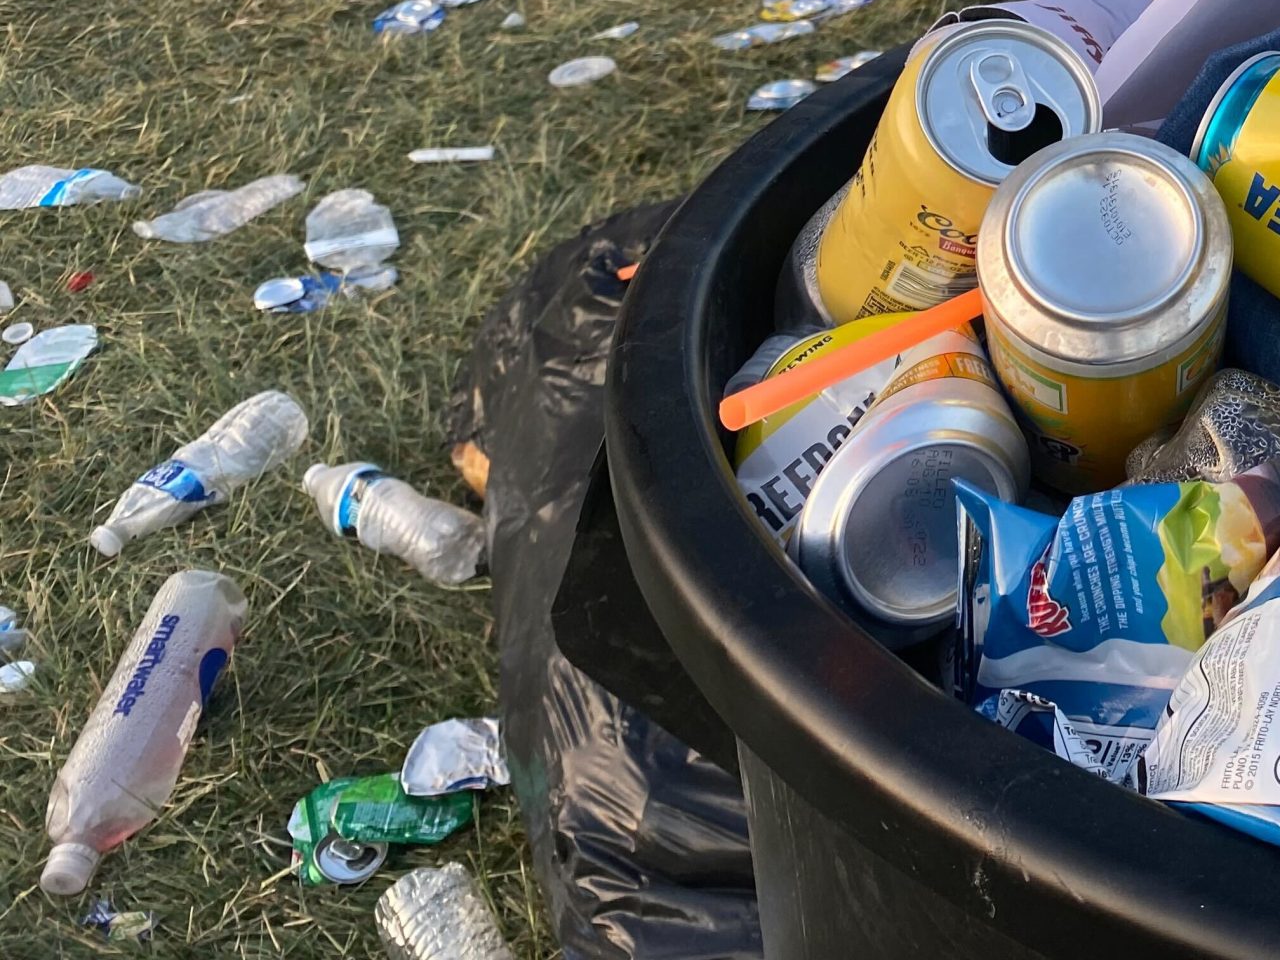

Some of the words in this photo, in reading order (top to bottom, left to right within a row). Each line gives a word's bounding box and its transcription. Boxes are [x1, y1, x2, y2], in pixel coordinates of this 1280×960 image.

[1061, 529, 1074, 554] have
[1099, 525, 1118, 574] STRENGTH
[1119, 521, 1133, 554] become
[1067, 553, 1081, 569] you
[1082, 541, 1097, 564] ARE
[1126, 554, 1137, 577] chips
[1072, 570, 1083, 592] when
[1087, 564, 1108, 614] CRUNCHES
[1110, 573, 1126, 610] DIPPING
[1130, 577, 1143, 599] your
[1078, 591, 1091, 623] Because
[1134, 595, 1144, 614] and
[1097, 614, 1111, 634] THE
[1117, 611, 1129, 629] THE
[113, 613, 180, 717] smartwater
[1254, 707, 1277, 753] FRITO-LAY
[1120, 742, 1136, 764] 13%
[1250, 752, 1263, 778] 2015
[1233, 752, 1250, 790] PLANO,
